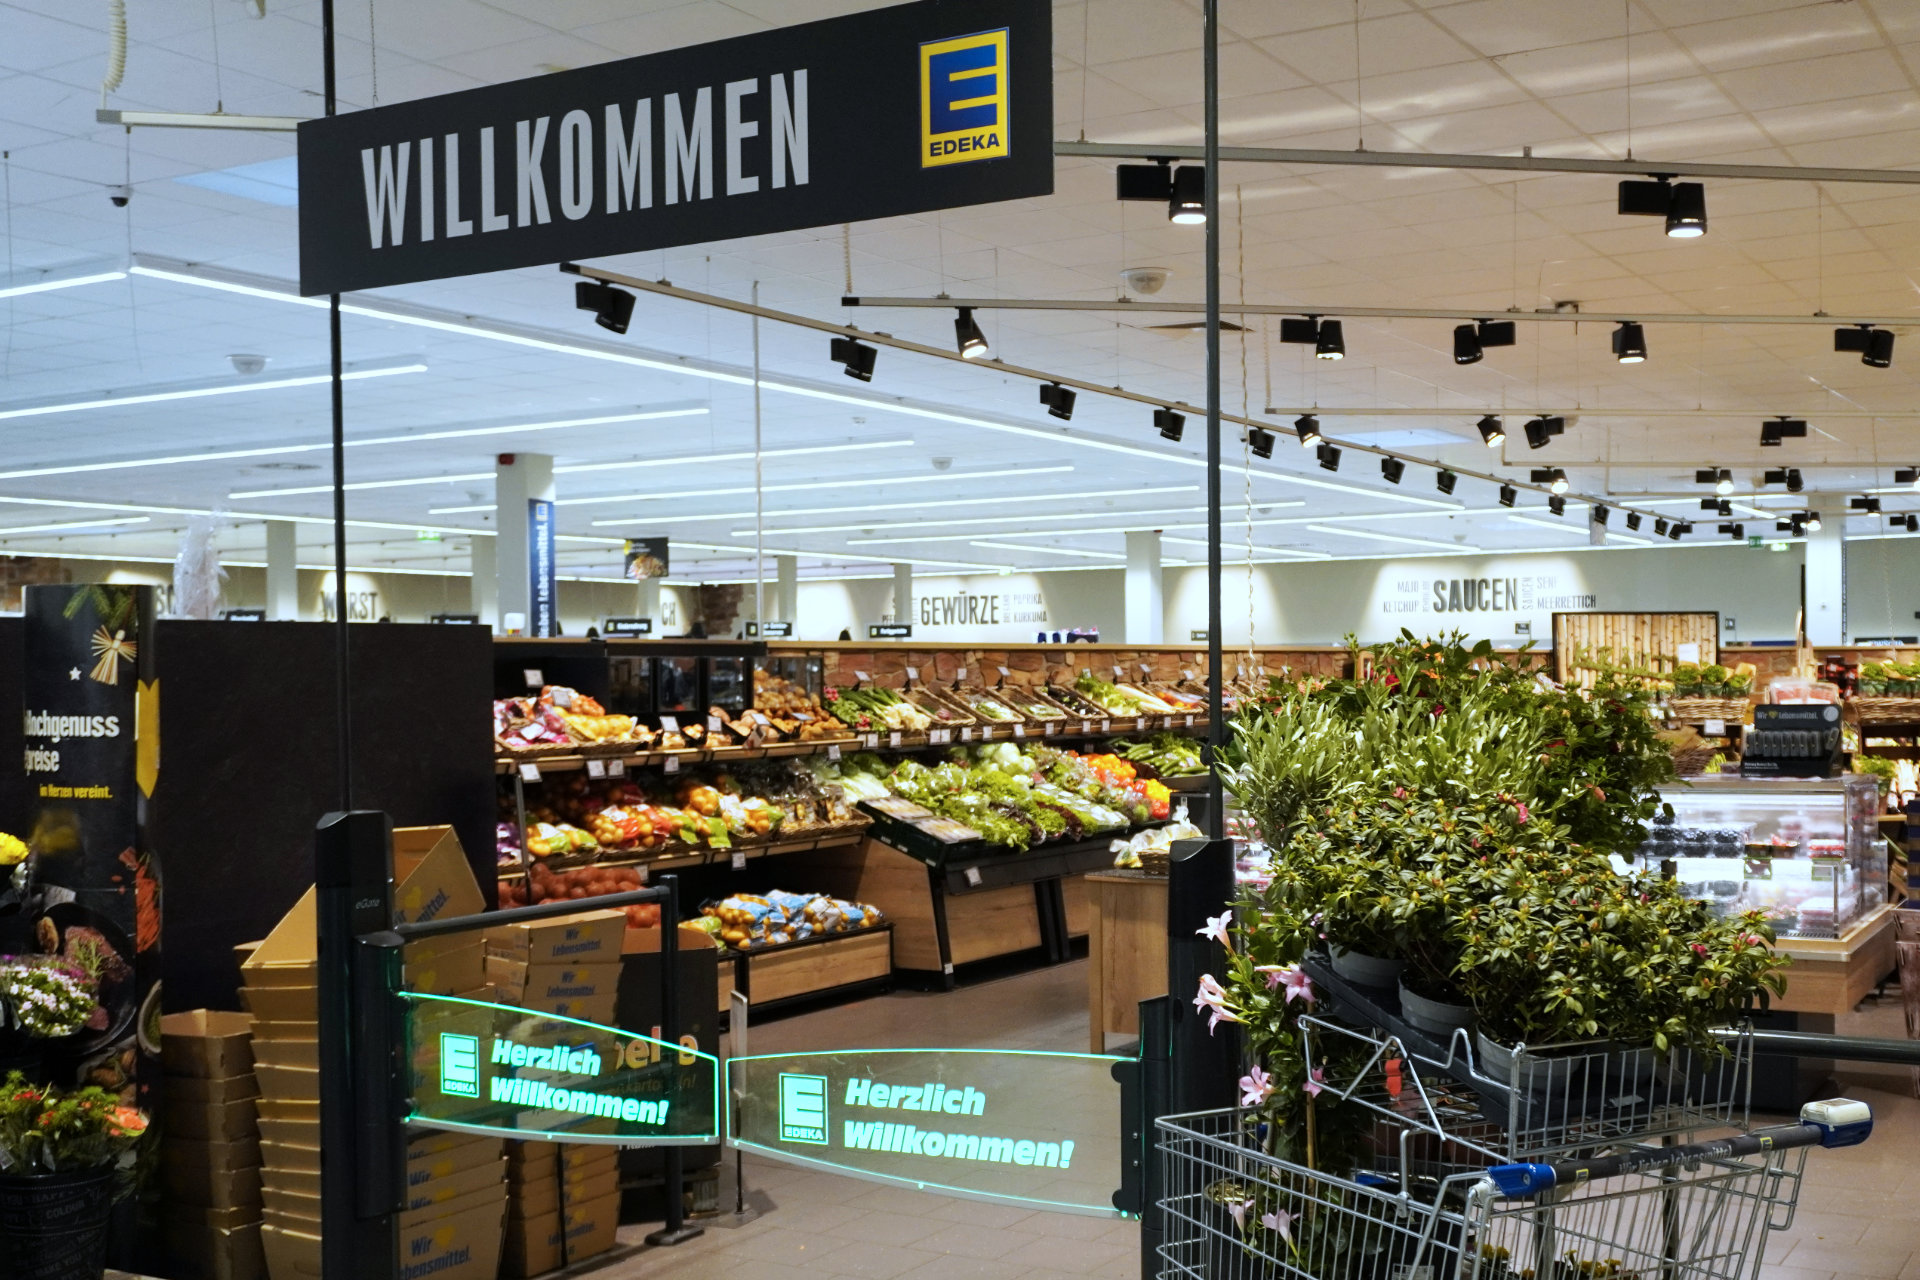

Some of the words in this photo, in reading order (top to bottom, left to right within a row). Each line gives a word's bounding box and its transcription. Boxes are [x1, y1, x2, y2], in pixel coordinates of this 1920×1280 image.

[929, 132, 1001, 158] EDEKA
[361, 68, 809, 249] WILLKOMMEN
[320, 592, 378, 620] WRST
[920, 590, 999, 626] GEWÜRZE
[1383, 600, 1419, 613] KETCHUP
[1433, 578, 1518, 613] SAUCEN
[1537, 595, 1597, 610] MEERRETTICH
[1013, 611, 1048, 623] KURKUMA
[1757, 711, 1767, 720] Wir
[1778, 711, 1819, 720] Lebensmittel.
[73, 784, 113, 798] vereint.
[490, 1038, 601, 1077] Herzlich
[443, 1079, 476, 1095] EDEKA
[844, 1078, 986, 1117] Herzlich
[490, 1076, 670, 1126] Willkommen!
[783, 1125, 824, 1141] EDEKA
[843, 1120, 1075, 1169] Willkommen!
[411, 1236, 433, 1257] Wir
